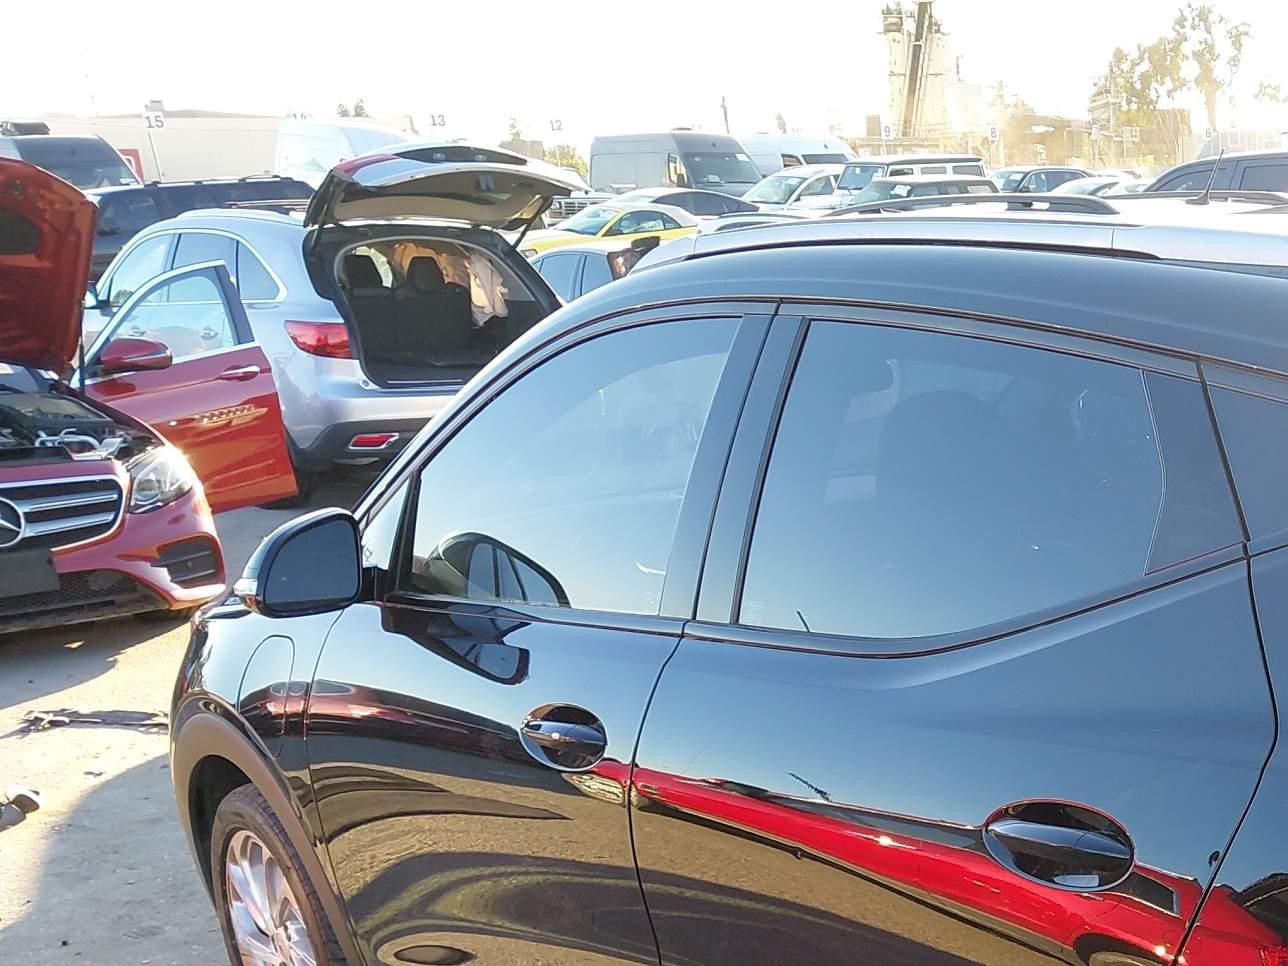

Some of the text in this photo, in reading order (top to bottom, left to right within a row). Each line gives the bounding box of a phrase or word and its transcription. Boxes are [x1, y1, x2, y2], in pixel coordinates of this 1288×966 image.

[145, 115, 165, 129] 15
[430, 114, 446, 127] 13
[550, 119, 563, 131] 12
[884, 125, 891, 137] 9
[990, 127, 997, 139] 8
[1205, 127, 1211, 138] 6
